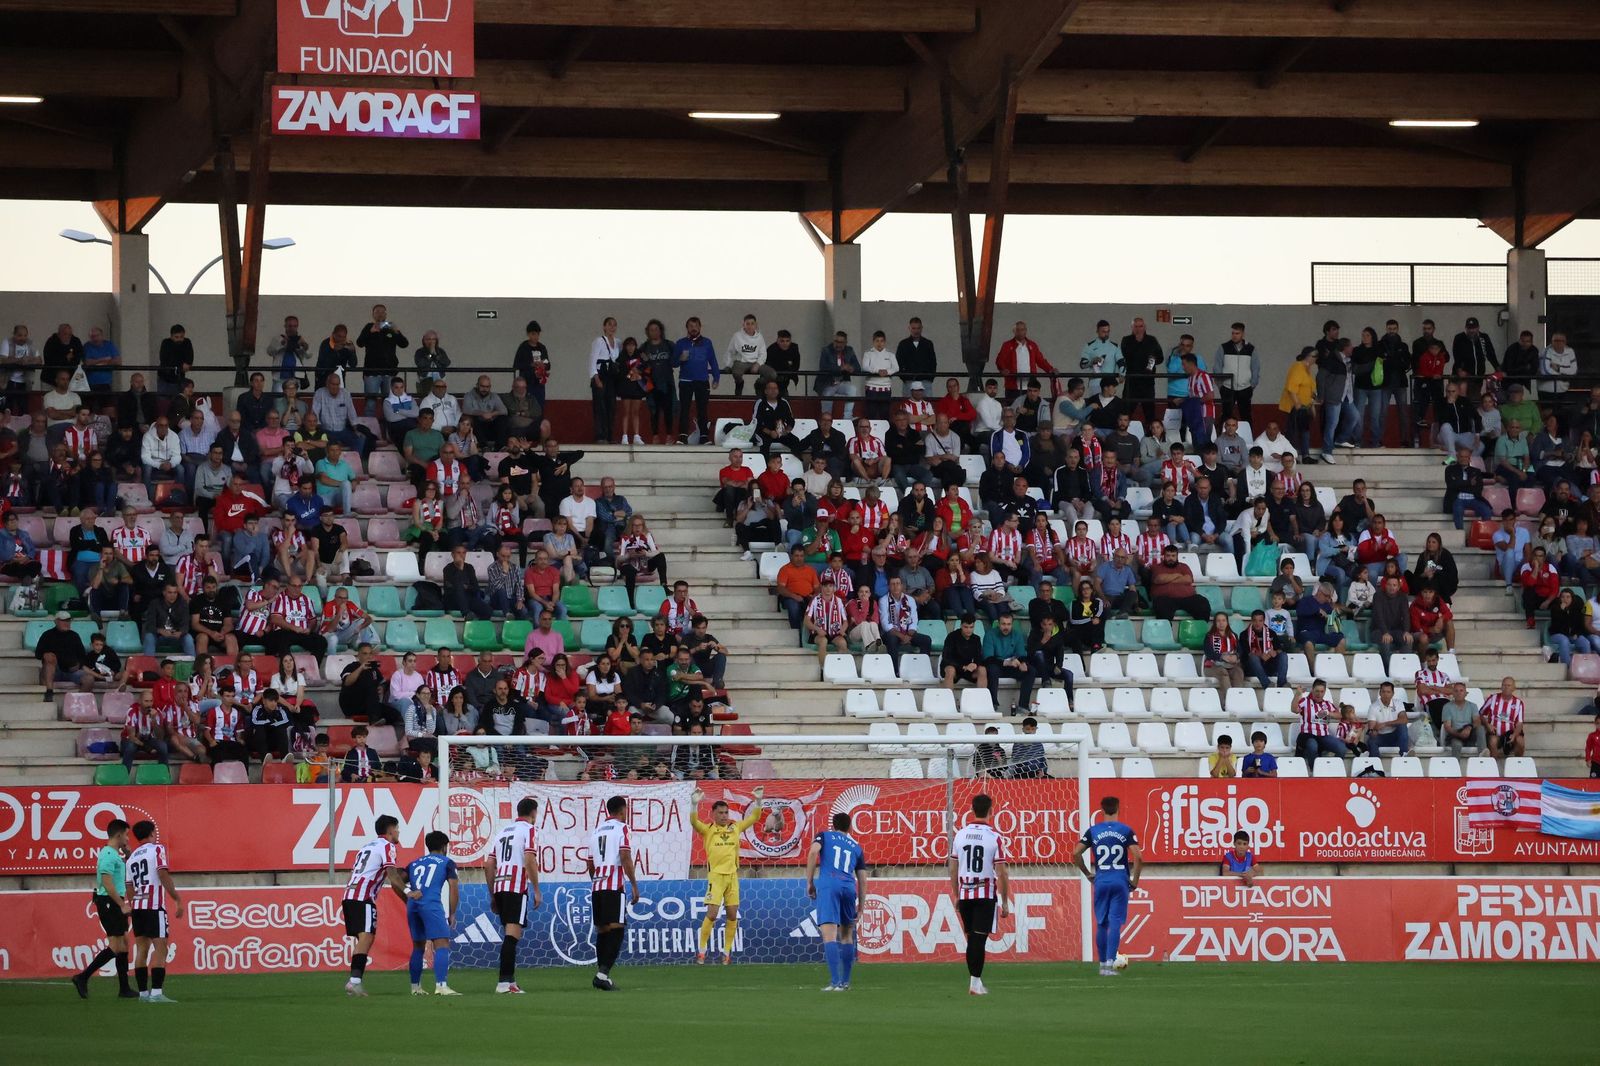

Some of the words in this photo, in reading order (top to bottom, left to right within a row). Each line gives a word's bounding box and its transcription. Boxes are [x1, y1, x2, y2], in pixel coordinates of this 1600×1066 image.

[300, 44, 452, 75] FUNDACIÓN
[278, 90, 475, 134] ZAMORACF
[1171, 784, 1269, 832] fisio
[8, 849, 17, 860] Y
[499, 835, 515, 862] 16
[598, 835, 608, 862] 4
[1299, 826, 1427, 857] podoactiva
[1316, 848, 1362, 858] PODOLOGÍA
[1364, 849, 1369, 857] Y
[1371, 848, 1426, 858] BIOMECÁNICA
[832, 845, 852, 873] 11
[962, 844, 985, 873] 18
[1096, 844, 1126, 870] 22
[130, 859, 150, 888] 22
[1169, 927, 1347, 962] ZAMORA
